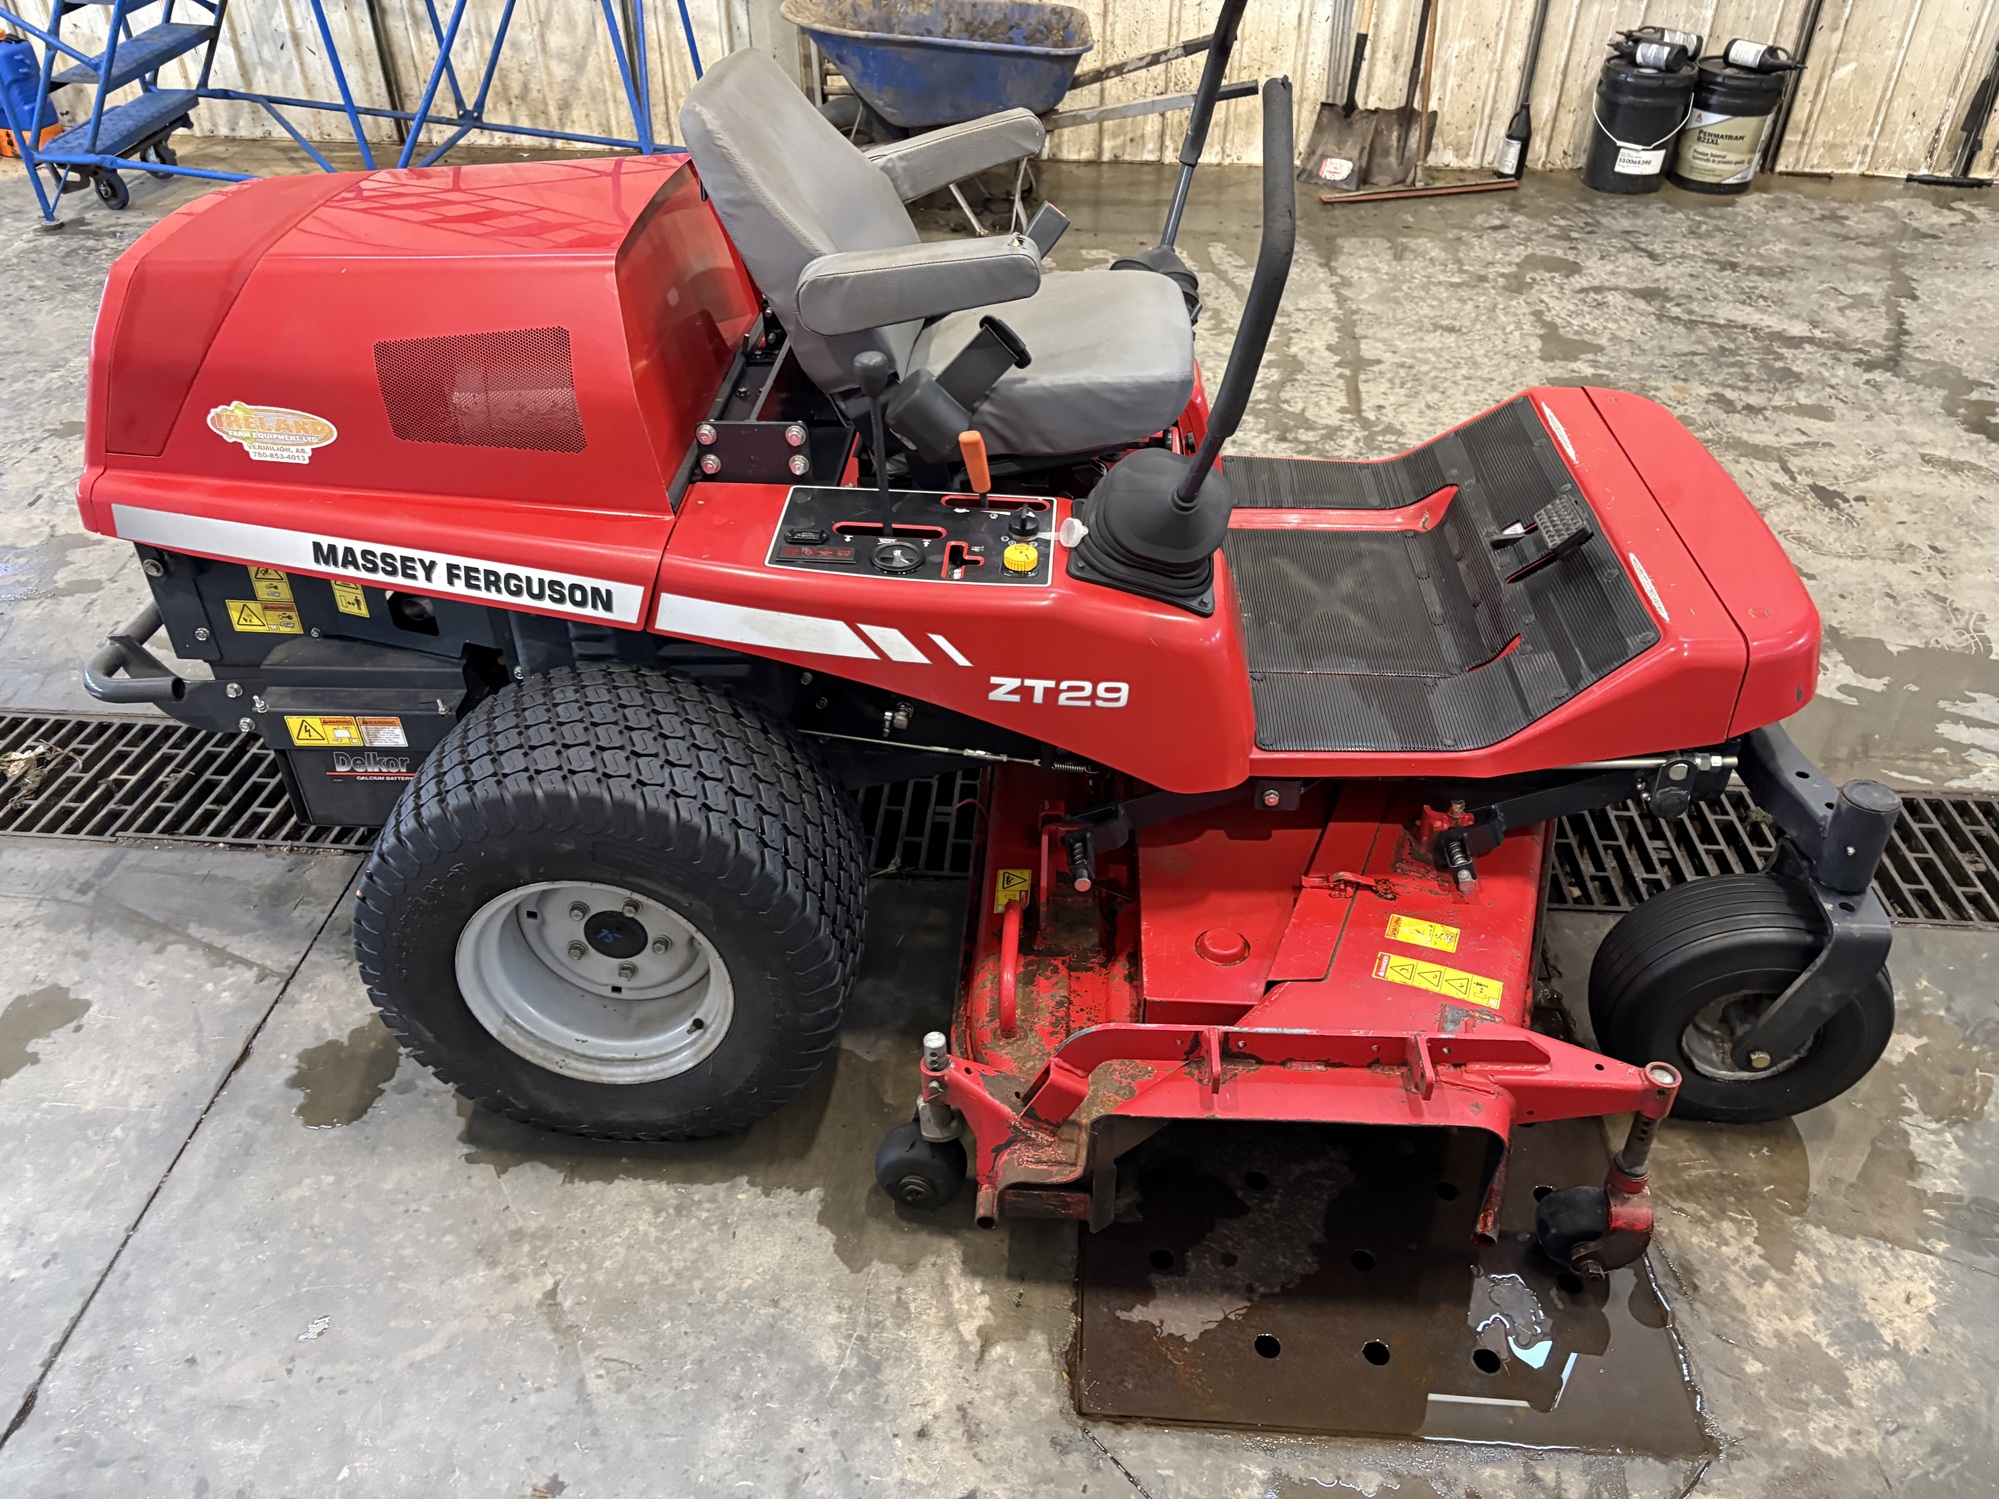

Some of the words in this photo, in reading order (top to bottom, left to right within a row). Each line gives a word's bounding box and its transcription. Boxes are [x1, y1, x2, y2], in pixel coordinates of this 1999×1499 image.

[1698, 129, 1746, 142] PERMATRAN
[215, 412, 330, 436] IRELAND
[228, 430, 251, 438] FARM
[253, 433, 302, 443] EQUIPMENT
[312, 540, 439, 581] MASSEY
[446, 562, 615, 612] FERGUSON
[987, 676, 1130, 709] ZT29
[333, 751, 410, 773] Delkor
